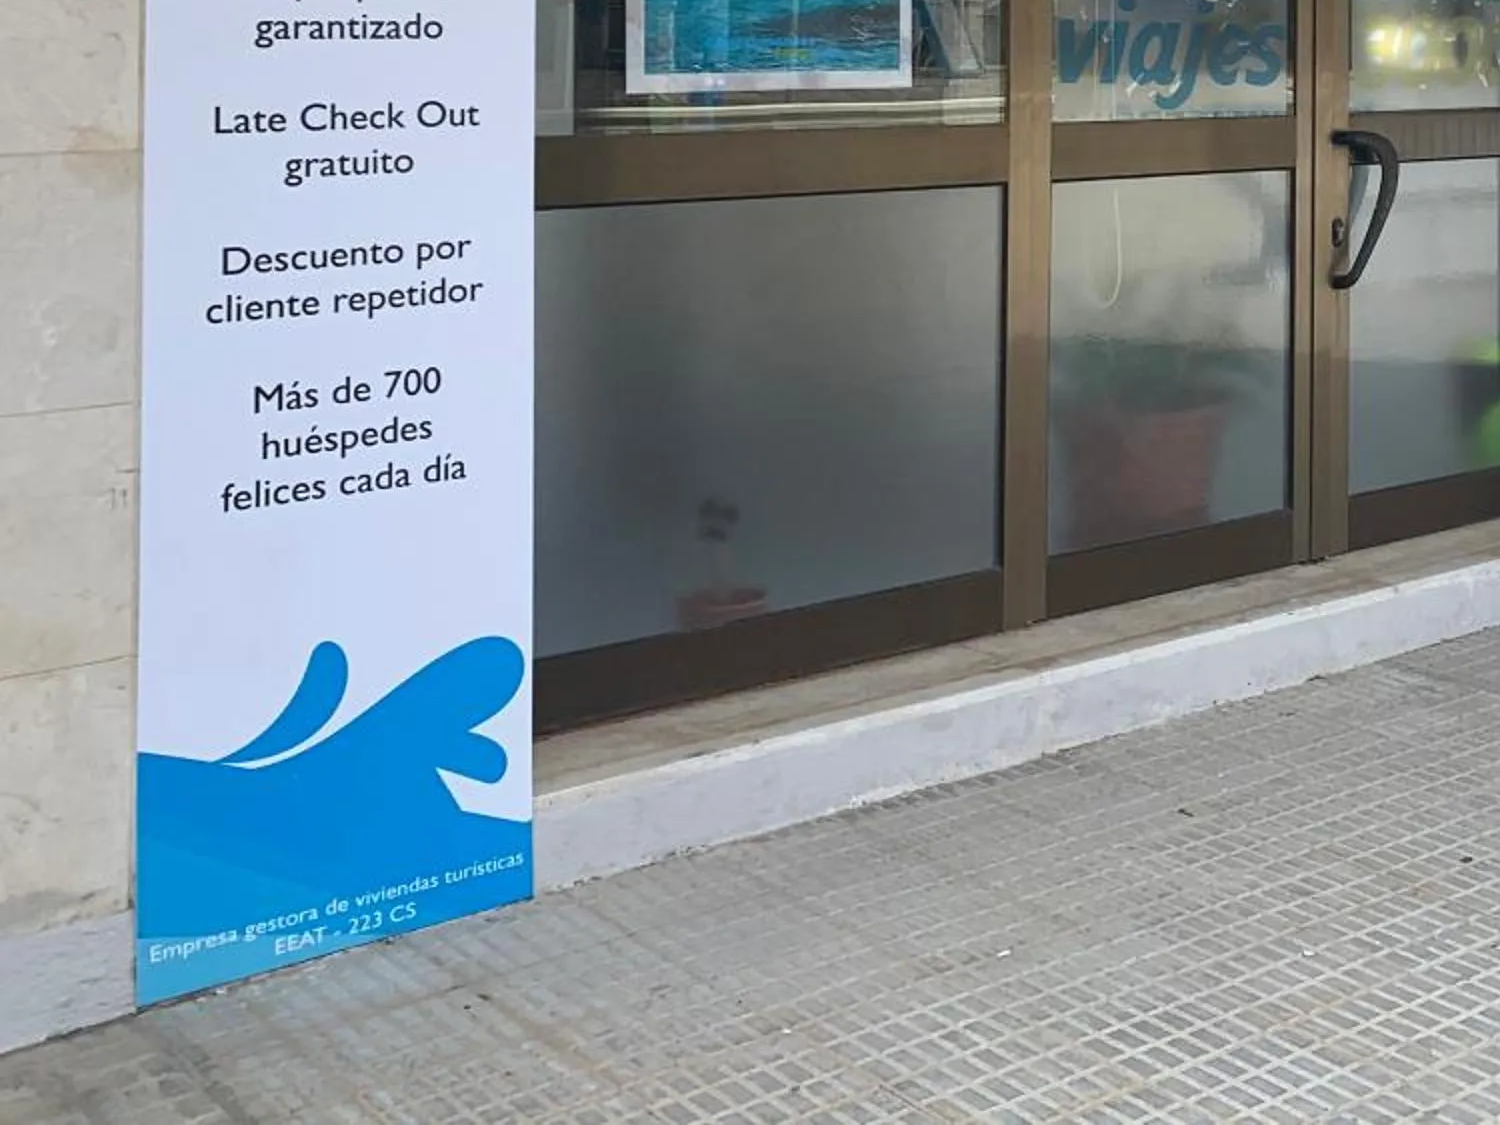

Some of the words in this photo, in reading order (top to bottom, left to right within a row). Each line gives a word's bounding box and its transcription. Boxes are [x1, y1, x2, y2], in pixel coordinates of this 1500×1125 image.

[253, 12, 444, 49] garantizado
[213, 106, 288, 134] Late
[300, 101, 406, 132] Check
[416, 100, 481, 128] Out
[283, 148, 415, 188] gratuito
[221, 241, 404, 276] Descuento
[416, 239, 472, 270] por
[205, 293, 321, 324] cliente
[333, 277, 484, 319] repetidor
[253, 380, 320, 414] Más
[332, 376, 372, 405] de
[383, 366, 442, 399] 700
[261, 416, 434, 460] huéspedes
[220, 479, 327, 513] felices
[338, 462, 411, 495] cada
[422, 452, 467, 483] día
[149, 928, 238, 964] Empresa
[244, 906, 319, 942] gestora
[325, 897, 349, 916] de
[354, 875, 440, 909] viviendas
[444, 851, 525, 885] turísticas
[274, 926, 328, 956] EEAT
[348, 912, 384, 936] 223
[389, 903, 418, 924] CS
